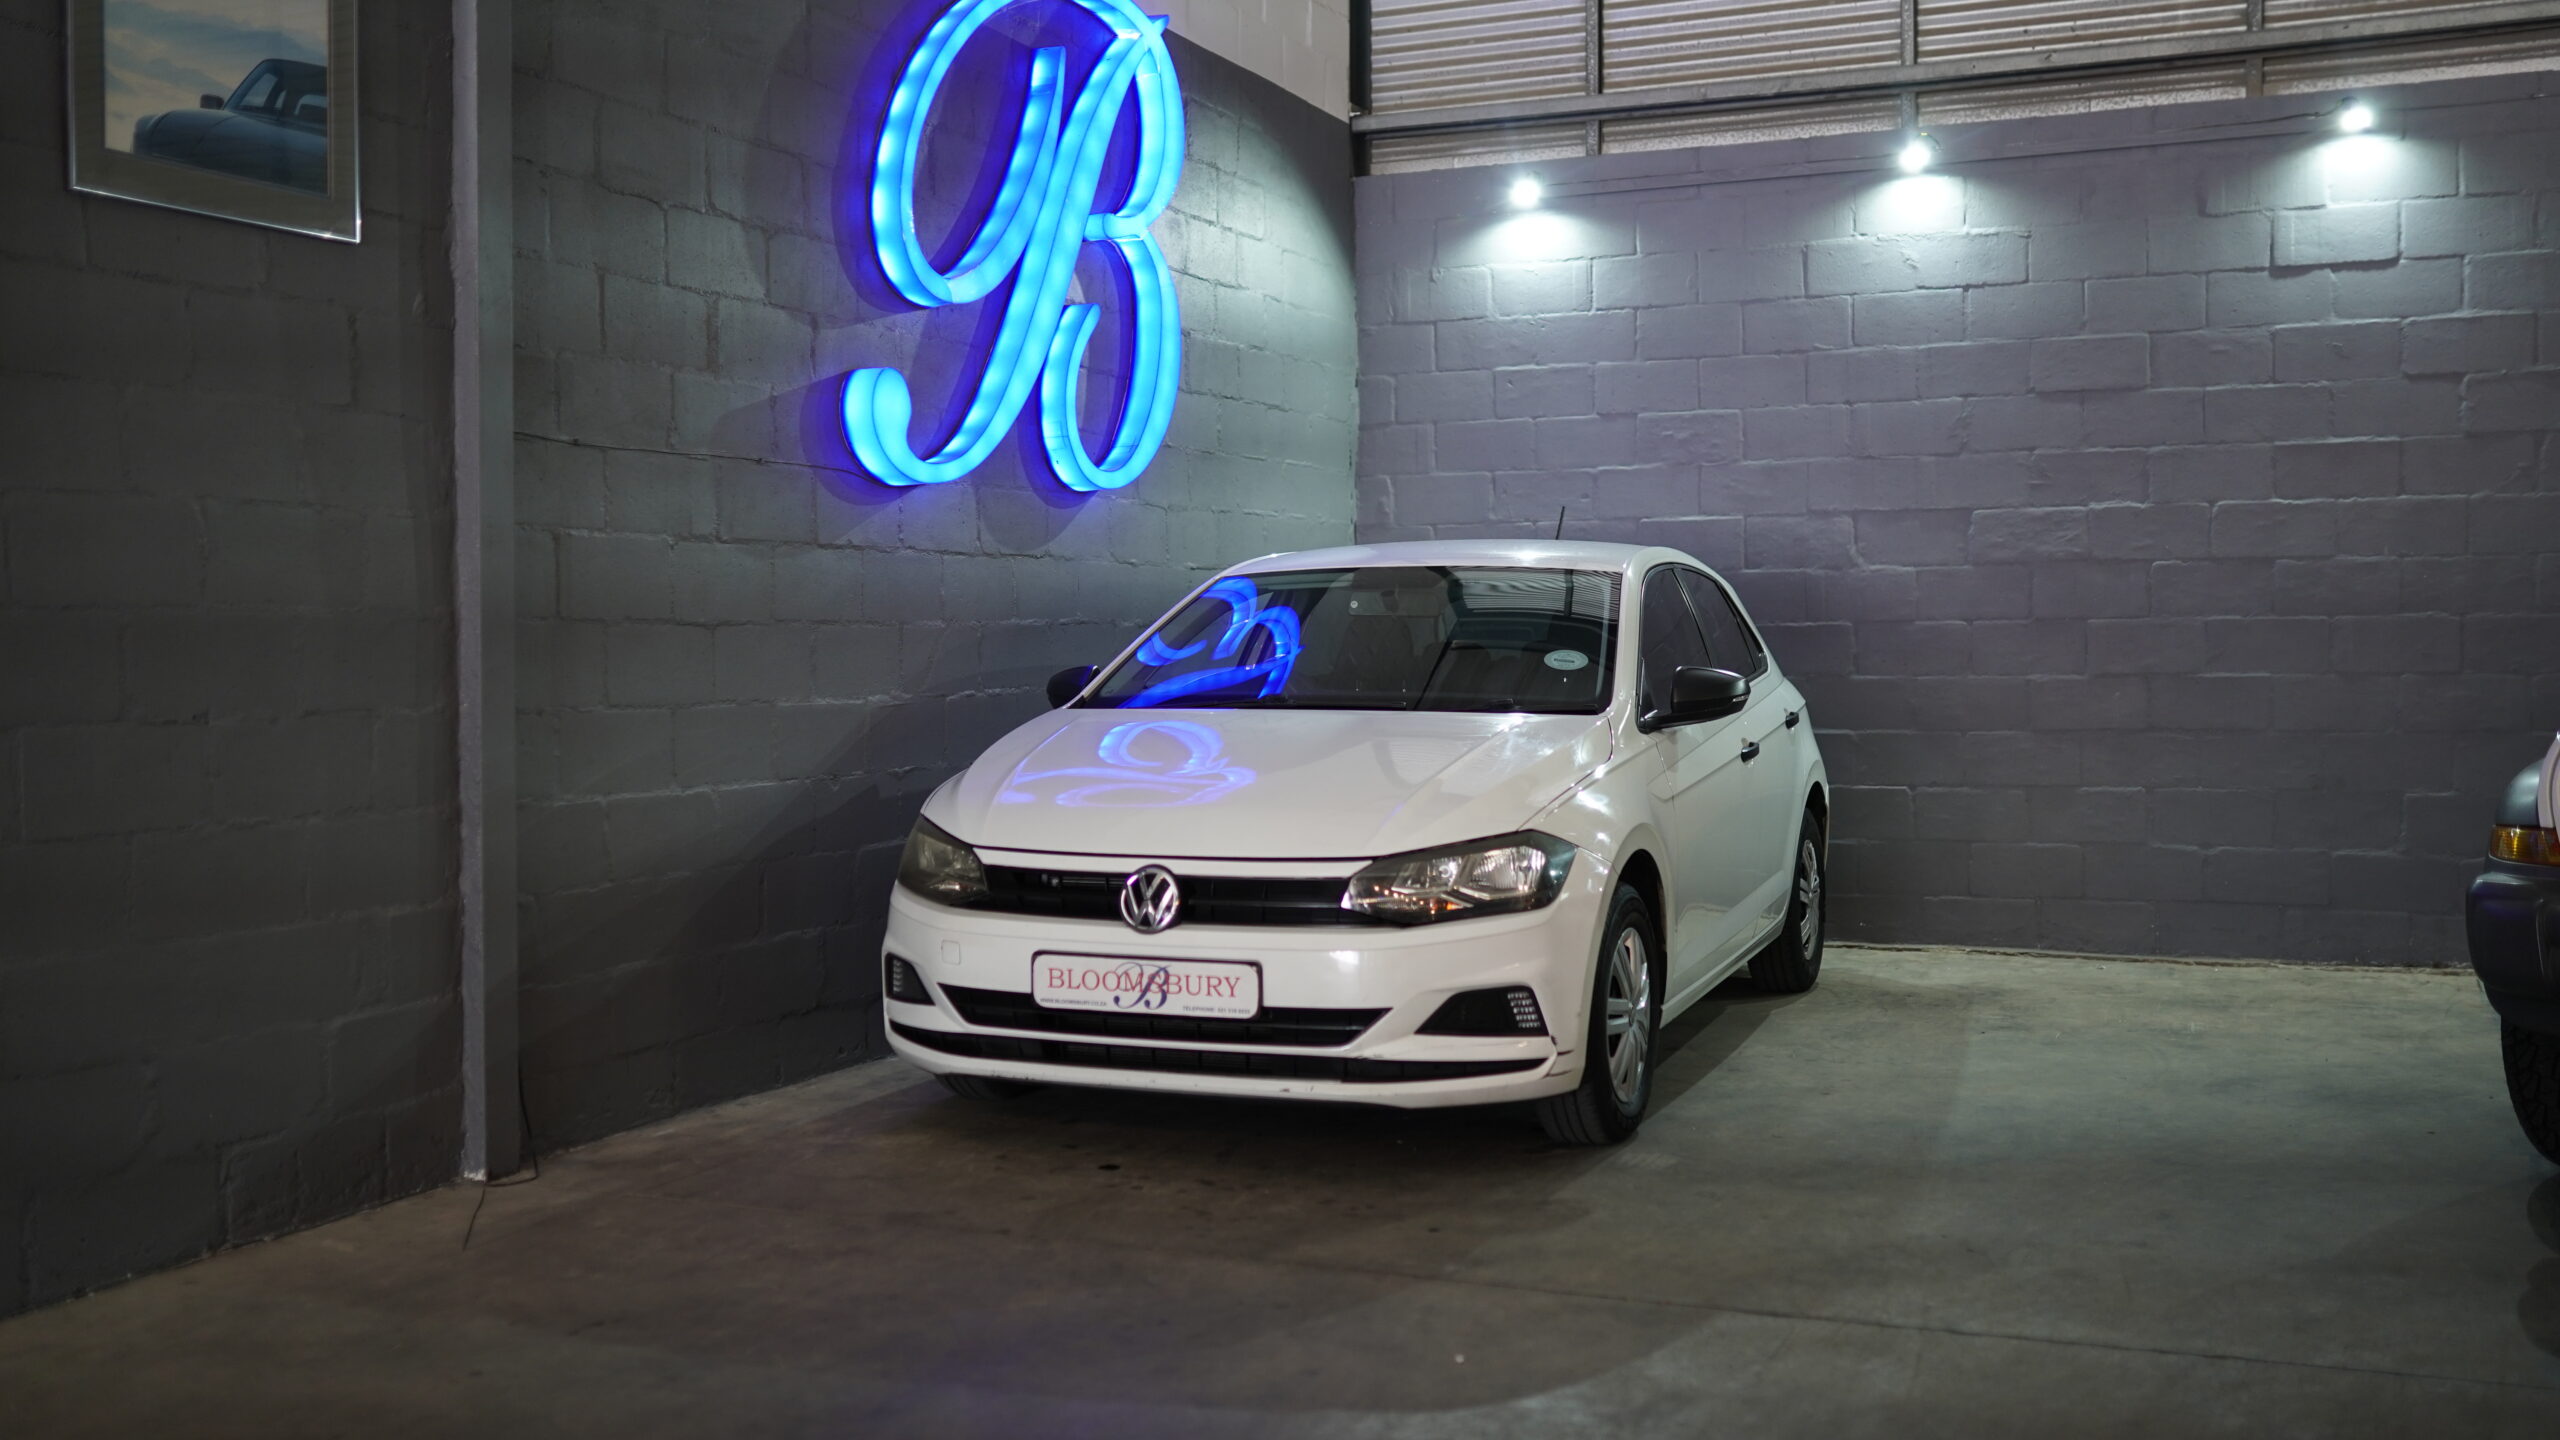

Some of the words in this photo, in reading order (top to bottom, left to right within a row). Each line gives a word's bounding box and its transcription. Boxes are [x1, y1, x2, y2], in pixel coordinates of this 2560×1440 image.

[840, 0, 1185, 492] B
[1122, 865, 1179, 933] VW
[1047, 967, 1241, 998] BLOOMSBURY
